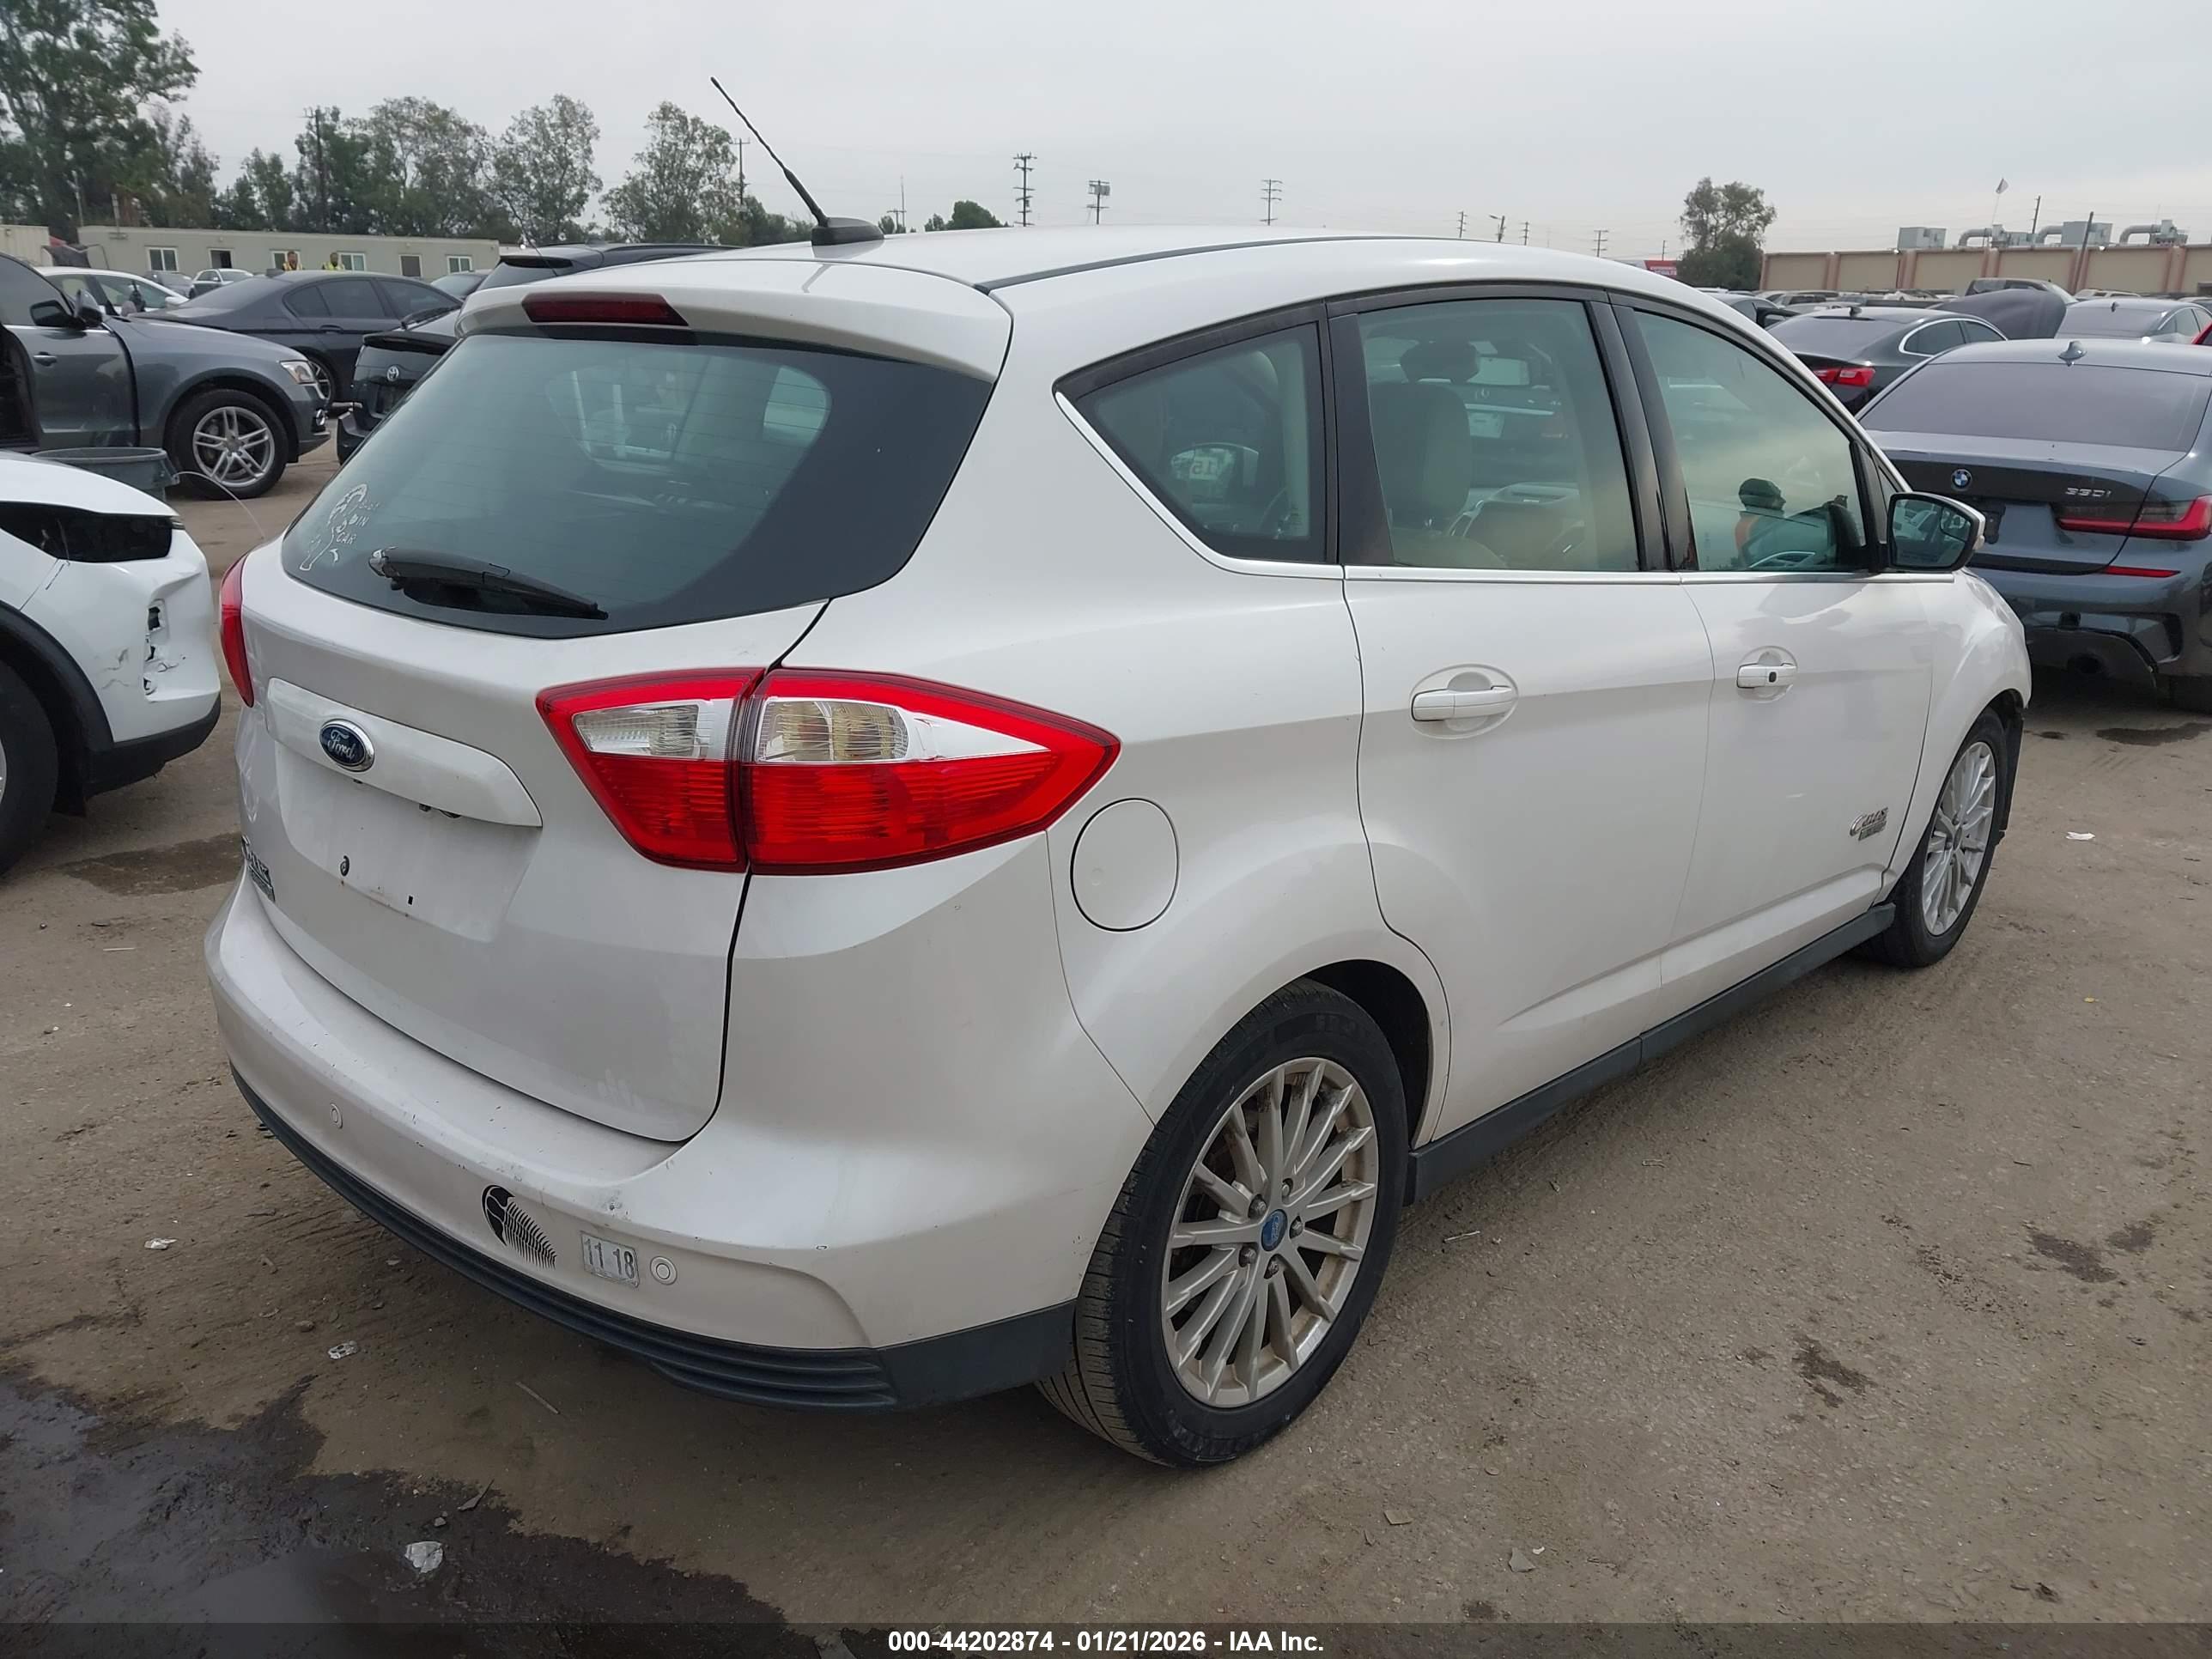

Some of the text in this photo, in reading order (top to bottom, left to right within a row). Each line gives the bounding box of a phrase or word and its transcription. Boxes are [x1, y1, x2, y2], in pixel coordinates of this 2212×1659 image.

[327, 729, 356, 760] Ford
[585, 1238, 635, 1279] 11 18
